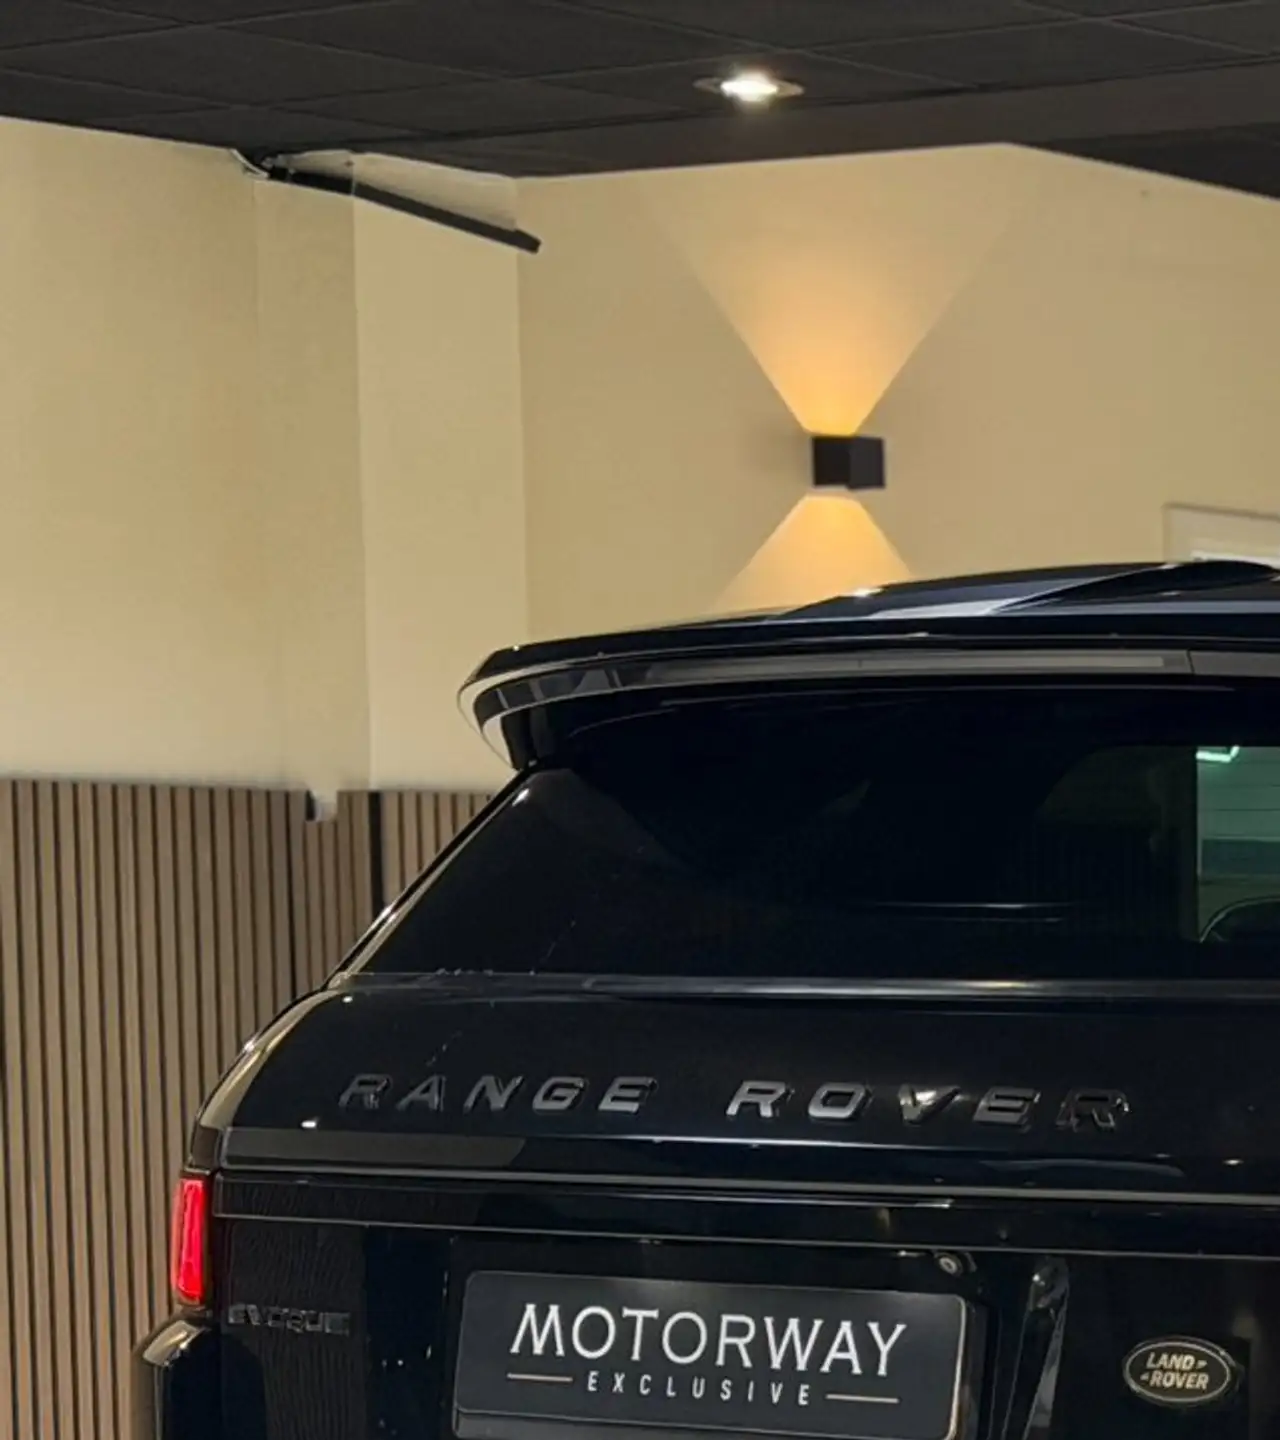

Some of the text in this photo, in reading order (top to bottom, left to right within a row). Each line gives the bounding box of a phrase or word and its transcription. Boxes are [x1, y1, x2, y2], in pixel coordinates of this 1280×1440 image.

[338, 1073, 1131, 1131] RANGE ROVER
[509, 1302, 908, 1377] MOTORWAY
[1145, 1351, 1196, 1371] LAND
[587, 1370, 810, 1406] EXCLUSIVE
[1148, 1369, 1210, 1390] ROVER
